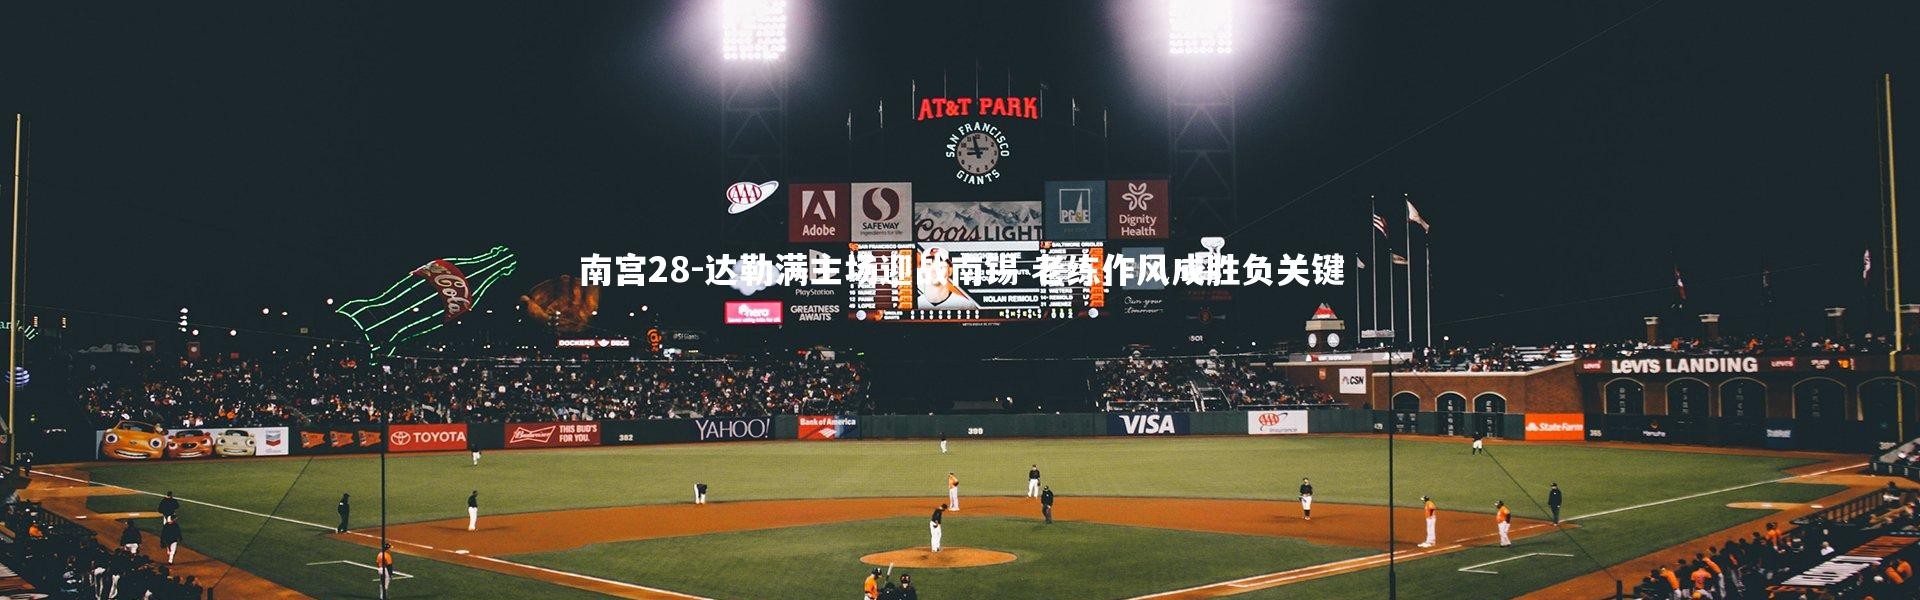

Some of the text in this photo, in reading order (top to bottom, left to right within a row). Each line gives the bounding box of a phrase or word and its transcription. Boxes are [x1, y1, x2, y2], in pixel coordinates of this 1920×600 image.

[918, 97, 1038, 120] AT&T PARK
[945, 121, 1010, 158] SAN FRANCISCO
[956, 170, 1000, 185] GIANTS
[728, 184, 762, 204] AAA
[1061, 209, 1090, 222] PG&E
[1119, 214, 1156, 226] Dignity
[802, 224, 836, 236] Adobe
[915, 218, 1042, 241] Coors LIGHT
[1121, 226, 1156, 236] Health
[434, 274, 471, 315] Cola
[795, 289, 834, 297] PlayStation
[790, 305, 840, 313] GREATNESS
[798, 313, 832, 322] AWAITS
[1666, 358, 1758, 372] LANDING
[1350, 376, 1364, 385] CSN
[800, 418, 856, 426] Bank of America
[1118, 414, 1176, 434] VISA
[1258, 414, 1280, 426] AAA
[514, 430, 552, 439] Budweiser
[560, 424, 598, 433] THIS BUD'S
[696, 418, 770, 440] YAHOO!
[413, 431, 466, 443] TOYOTA
[560, 434, 590, 443] FOR YOU.
